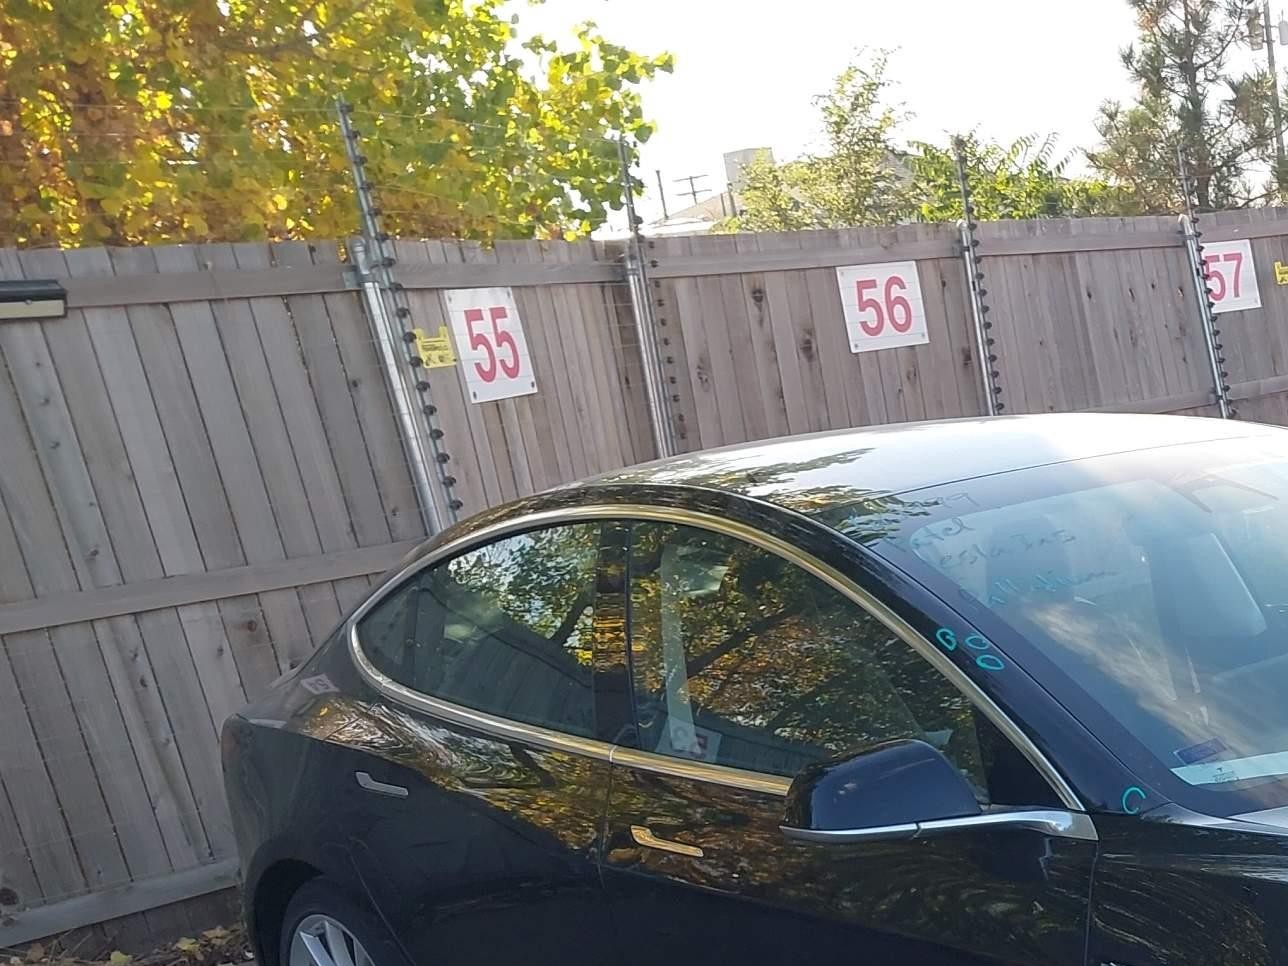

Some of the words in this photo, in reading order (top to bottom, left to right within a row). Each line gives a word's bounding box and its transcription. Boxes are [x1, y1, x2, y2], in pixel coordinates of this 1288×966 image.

[855, 275, 913, 337] 56
[1204, 251, 1243, 302] 57
[465, 306, 521, 384] 55
